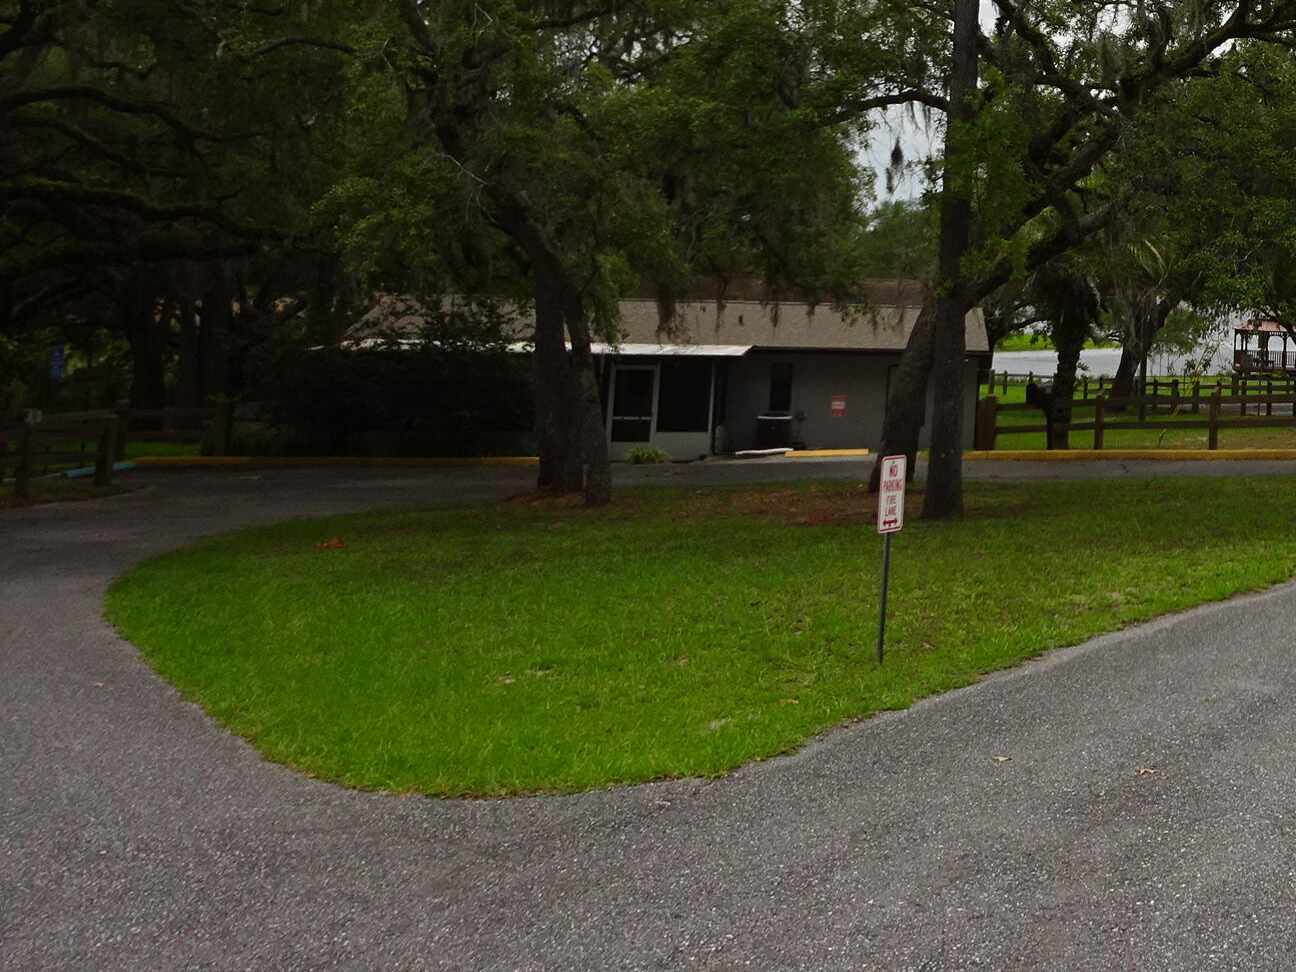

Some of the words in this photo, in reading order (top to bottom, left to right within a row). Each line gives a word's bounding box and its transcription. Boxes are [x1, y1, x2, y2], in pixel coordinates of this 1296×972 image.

[888, 464, 898, 477] NO
[883, 479, 902, 492] PARKING
[886, 495, 897, 504] FIRE
[885, 506, 897, 517] LANE
